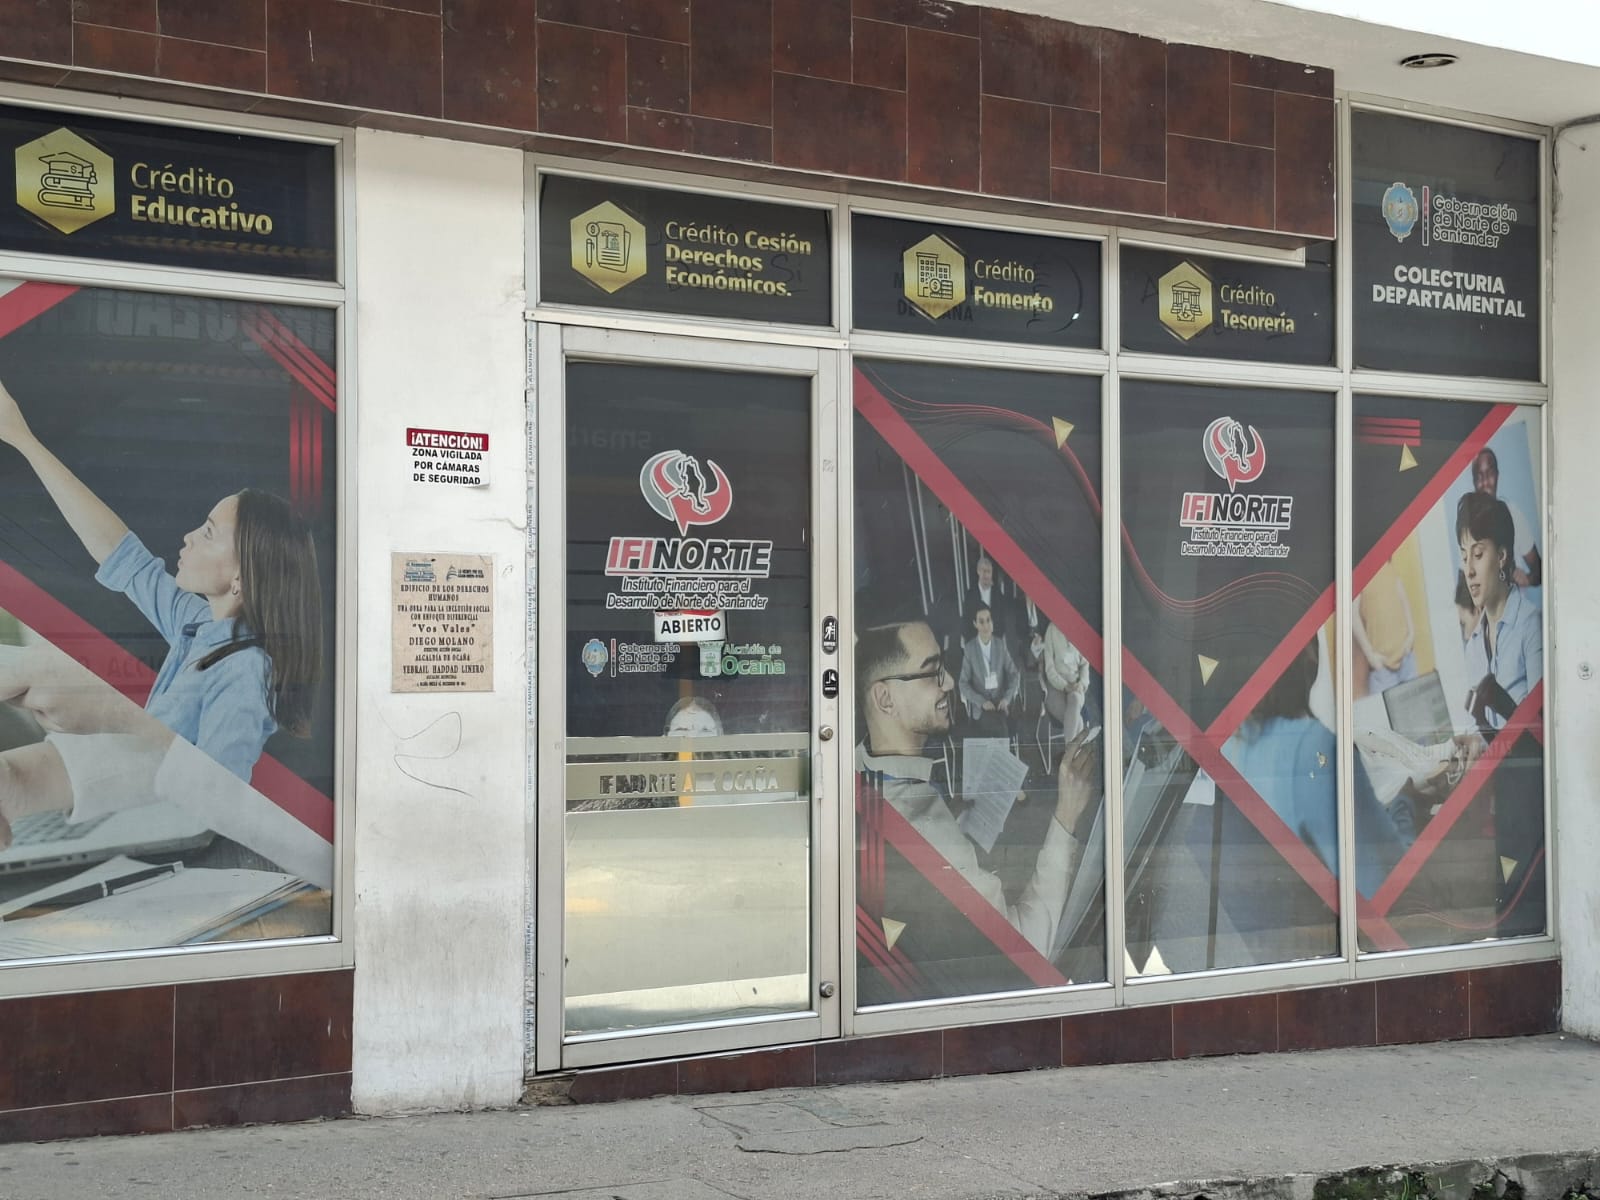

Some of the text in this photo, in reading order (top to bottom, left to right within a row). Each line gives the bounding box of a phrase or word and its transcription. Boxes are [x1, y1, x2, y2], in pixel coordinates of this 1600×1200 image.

[131, 162, 234, 199] Crédito
[131, 195, 273, 236] Educativo
[1432, 194, 1518, 222] Gobernación
[1432, 212, 1510, 235] de Norte de
[665, 221, 812, 256] Crédito Cesión
[1432, 225, 1500, 249] Santander
[665, 243, 763, 272] Derechos
[974, 258, 1035, 284] Crédito
[1394, 265, 1505, 295] COLECTURIA
[665, 266, 792, 297] Económicos.
[974, 285, 1054, 313] Fomento
[1220, 284, 1275, 307] Crédito
[1372, 284, 1526, 318] DEPARTAMENTAL
[1220, 309, 1296, 334] Tesorería
[411, 431, 483, 451] ¡ATENCIÓN!
[412, 447, 483, 461] ZONA VIGILADA
[414, 460, 480, 473] POR CÁMARAS
[413, 473, 481, 485] DE SEGURIDAD
[1181, 493, 1293, 523] IFINORTE
[1191, 527, 1278, 544] Instituto Financiero para el
[605, 537, 773, 571] IFINORTE
[1181, 541, 1290, 558] Desarrollo de Norte de Santander
[400, 584, 430, 592] EDIFICIO
[457, 585, 489, 593] DERECHOS
[622, 576, 751, 596] Instituto Financiero para el
[424, 604, 437, 612] PARA
[606, 593, 768, 610] Desarrollo de Norte de Santander
[660, 617, 721, 635] ABIERTO
[409, 637, 475, 646] DIEGO MOLANO
[618, 642, 681, 654] Gobernación
[723, 643, 782, 655] Alcaldía de
[415, 653, 441, 661] ALCALDÍA
[452, 653, 470, 661] OCAÑA
[618, 652, 675, 663] de Norte de
[721, 654, 786, 675] Ocaña
[402, 664, 485, 674] YEBRAIL HADDAD LINERO
[618, 662, 667, 673] Santander
[722, 765, 779, 792] OCAÑA
